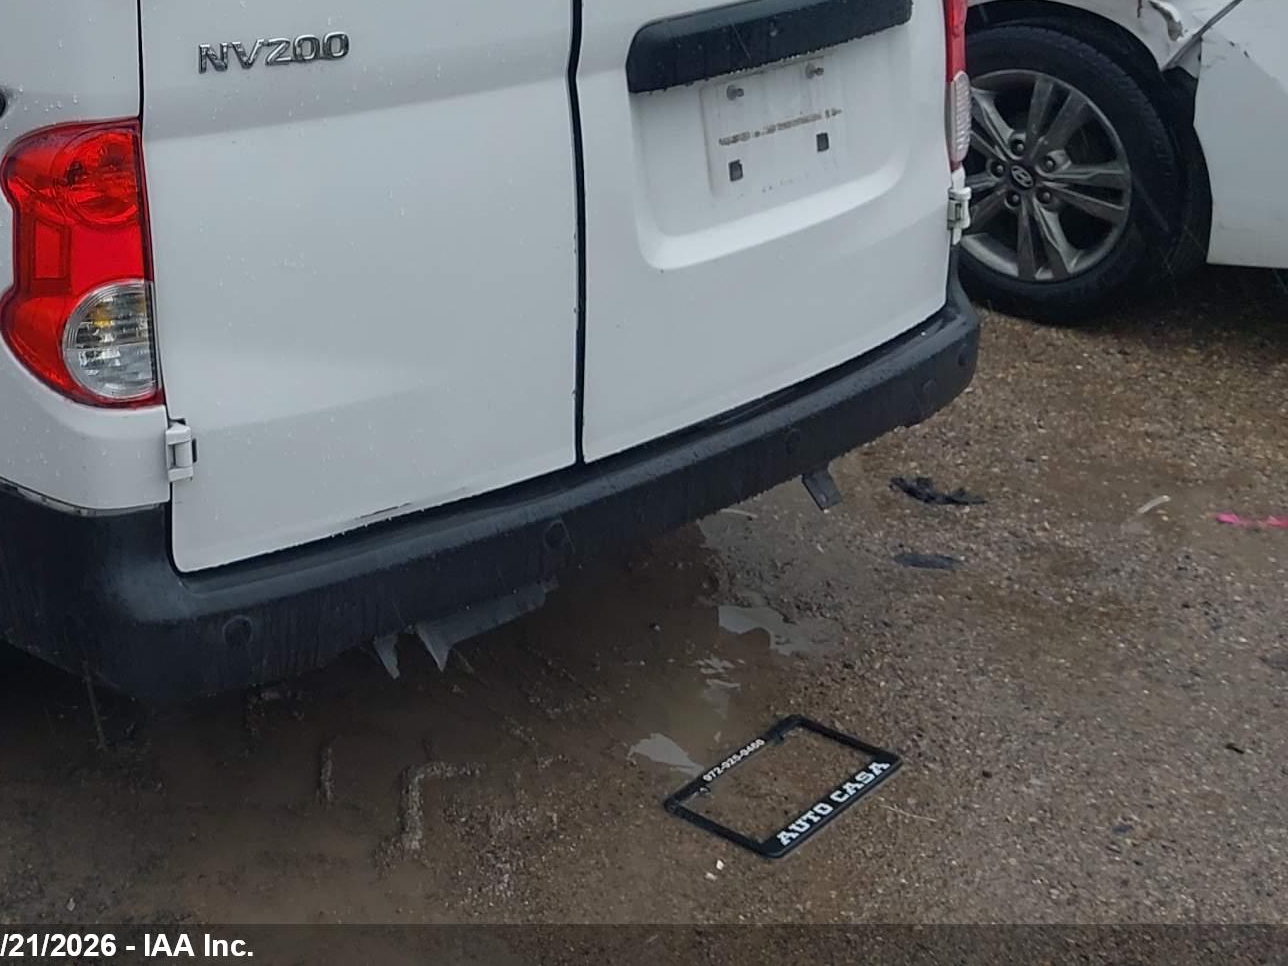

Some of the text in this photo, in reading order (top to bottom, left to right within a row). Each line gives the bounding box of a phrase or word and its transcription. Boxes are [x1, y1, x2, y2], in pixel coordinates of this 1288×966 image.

[198, 31, 350, 74] NV200
[776, 762, 891, 846] AUTO CASA
